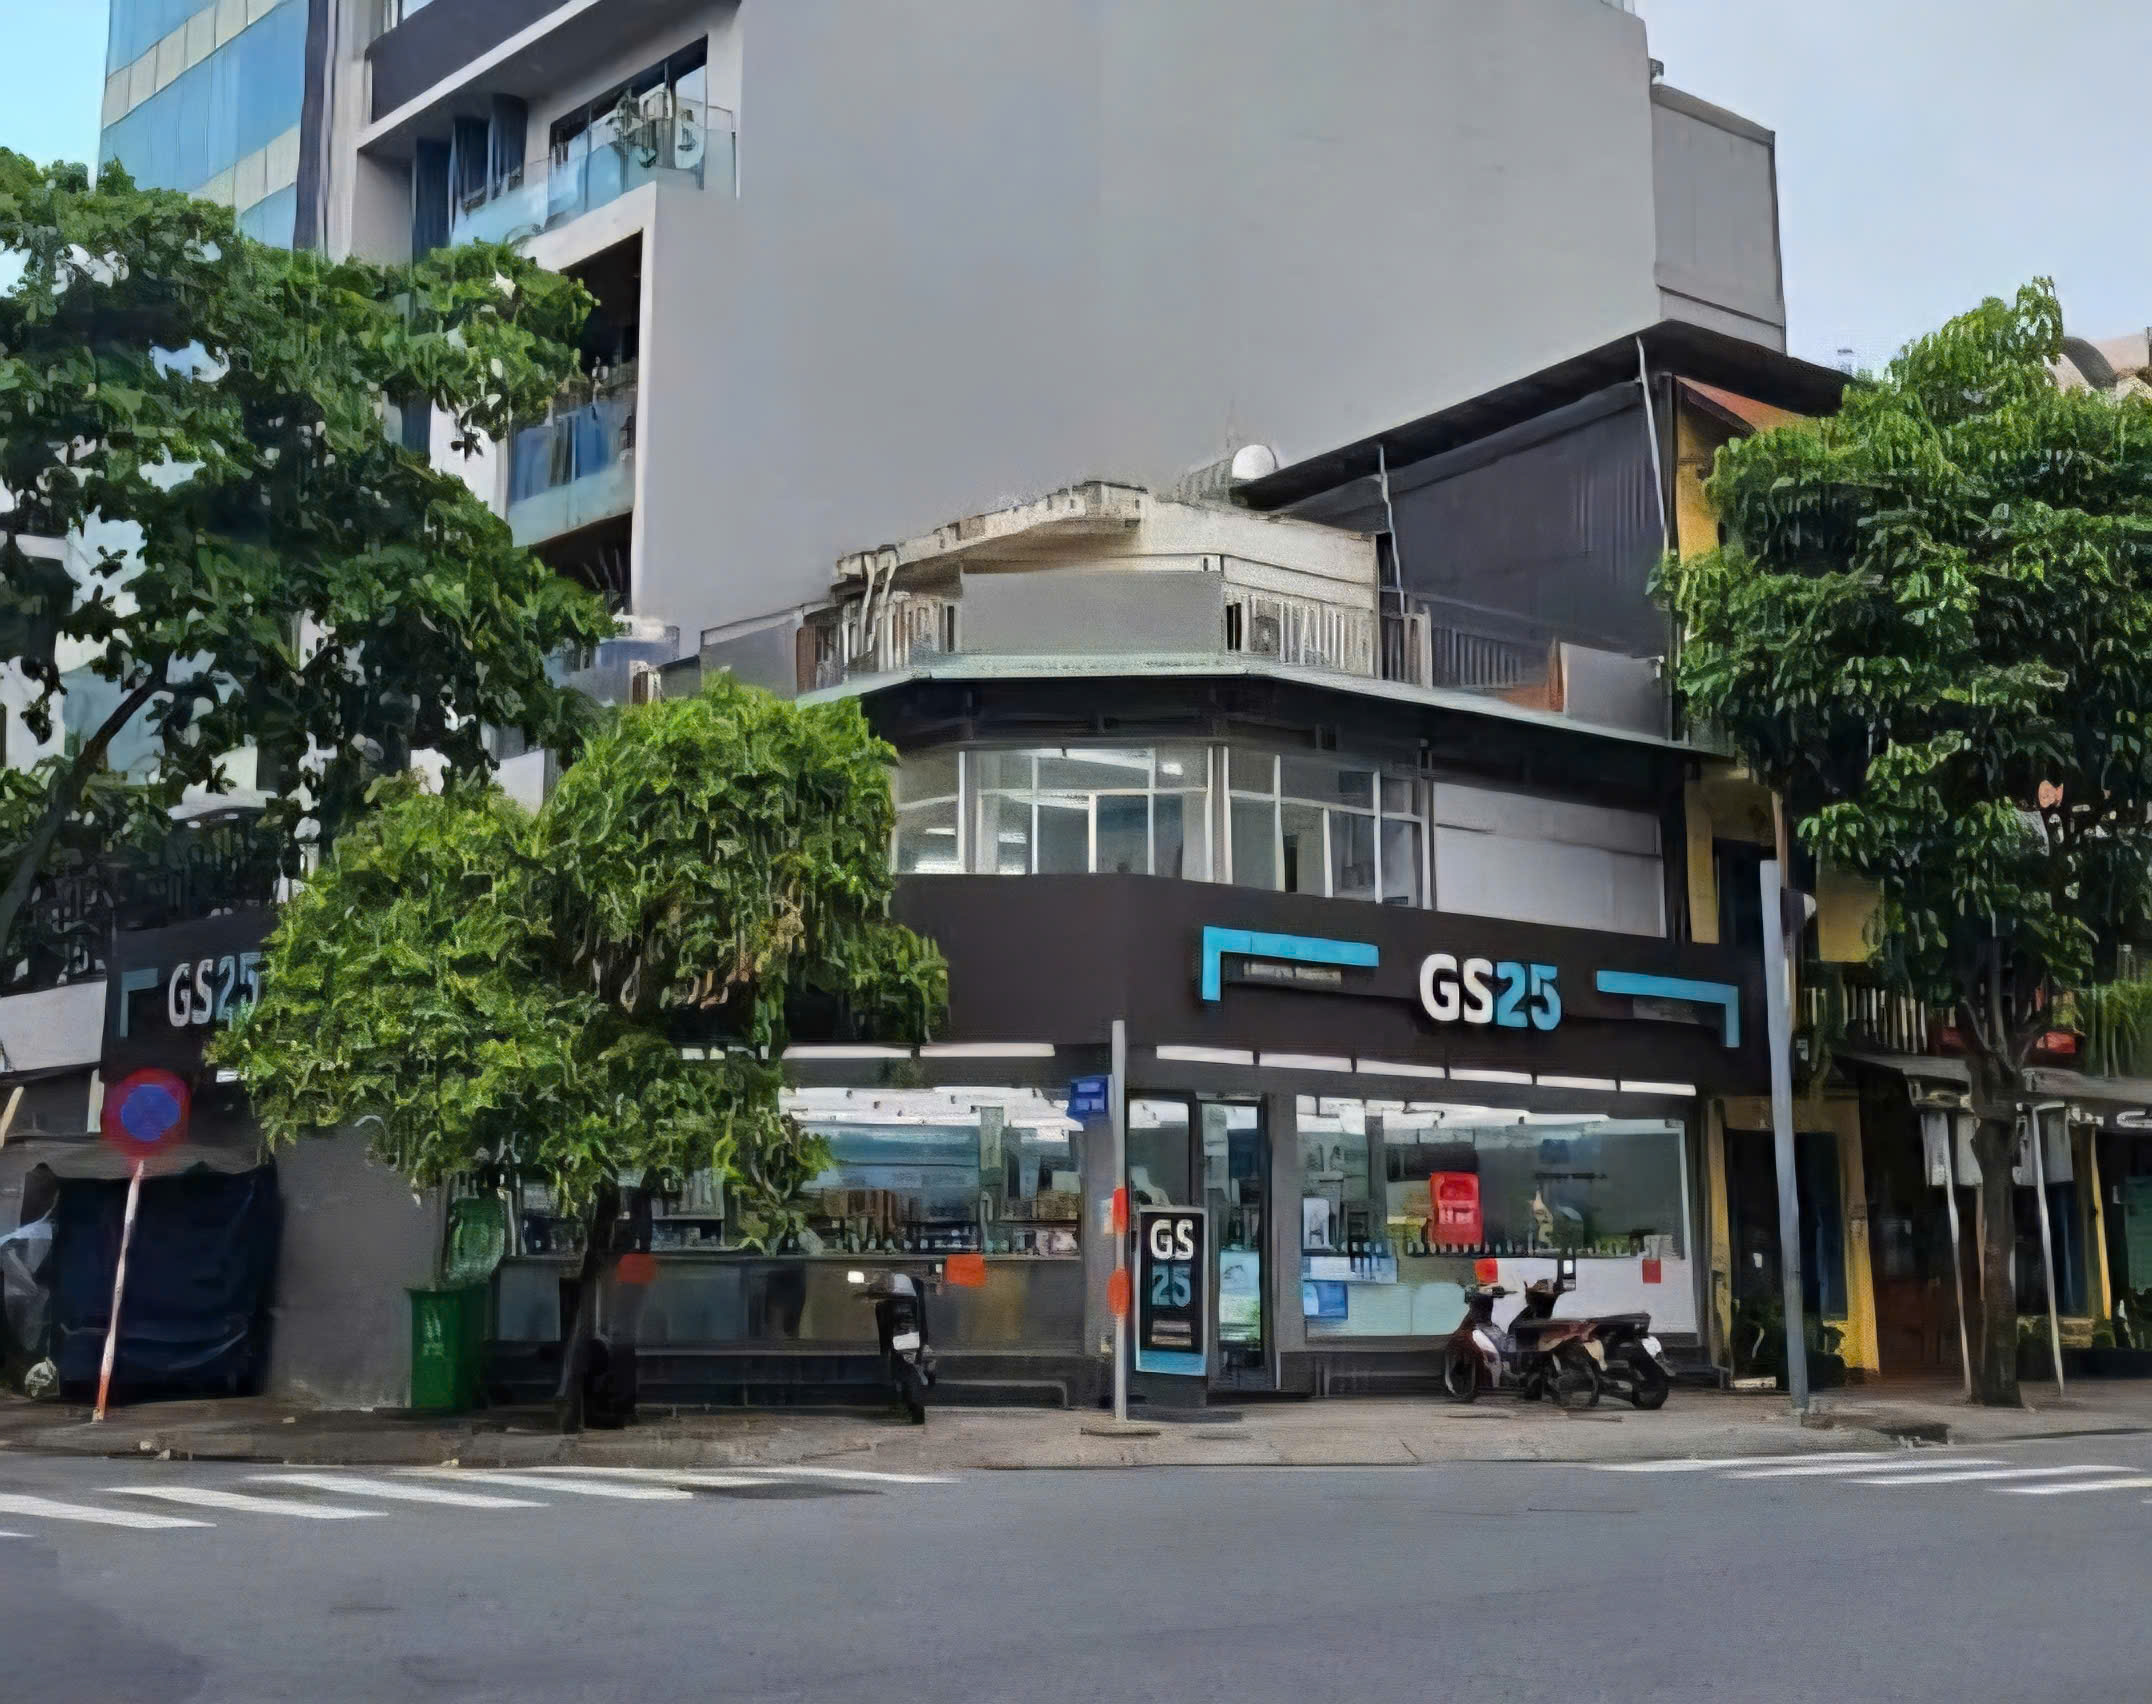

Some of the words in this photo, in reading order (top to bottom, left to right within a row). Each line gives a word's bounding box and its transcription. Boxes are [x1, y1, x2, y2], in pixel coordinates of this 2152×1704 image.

[1419, 953, 1561, 1030] GS25
[1150, 1218, 1194, 1261] GS
[1152, 1264, 1192, 1307] 25
